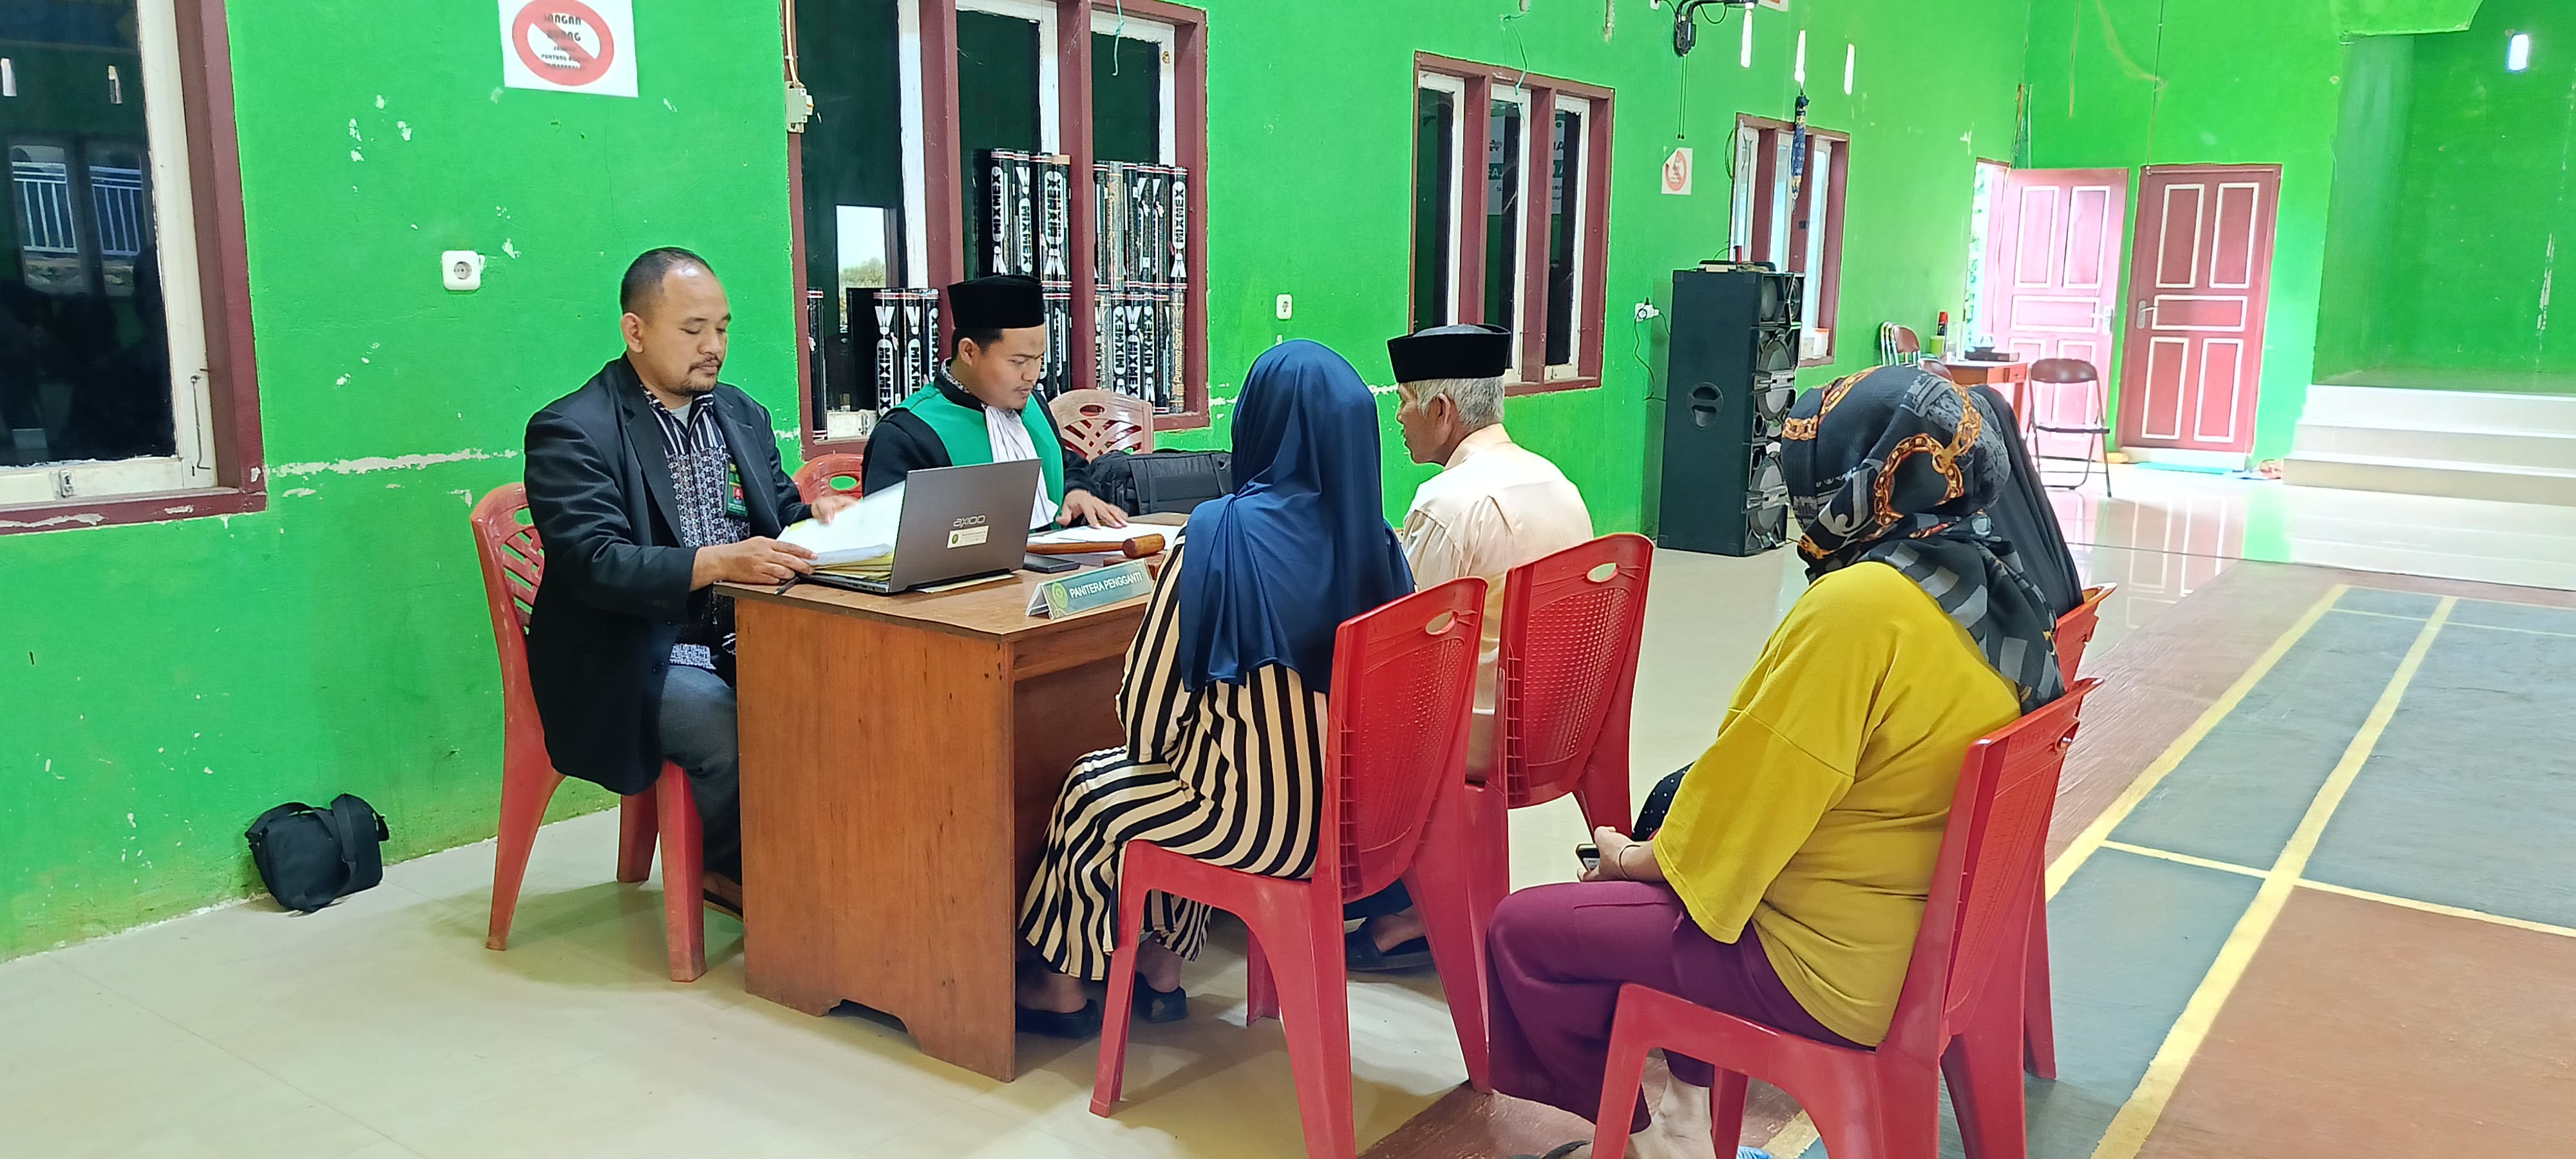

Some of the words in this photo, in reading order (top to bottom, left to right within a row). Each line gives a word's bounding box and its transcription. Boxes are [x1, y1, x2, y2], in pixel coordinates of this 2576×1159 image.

[992, 174, 1001, 235] MIXMEX
[1175, 189, 1184, 243] MIXMEX
[1021, 205, 1032, 265] MIXMEX
[1115, 315, 1124, 368] MIXMEX
[1128, 341, 1139, 396] MIXMEX
[878, 347, 891, 410] MIXMEX
[1069, 581, 1105, 599] PANITERA
[1104, 572, 1142, 590] PENGGANTI
